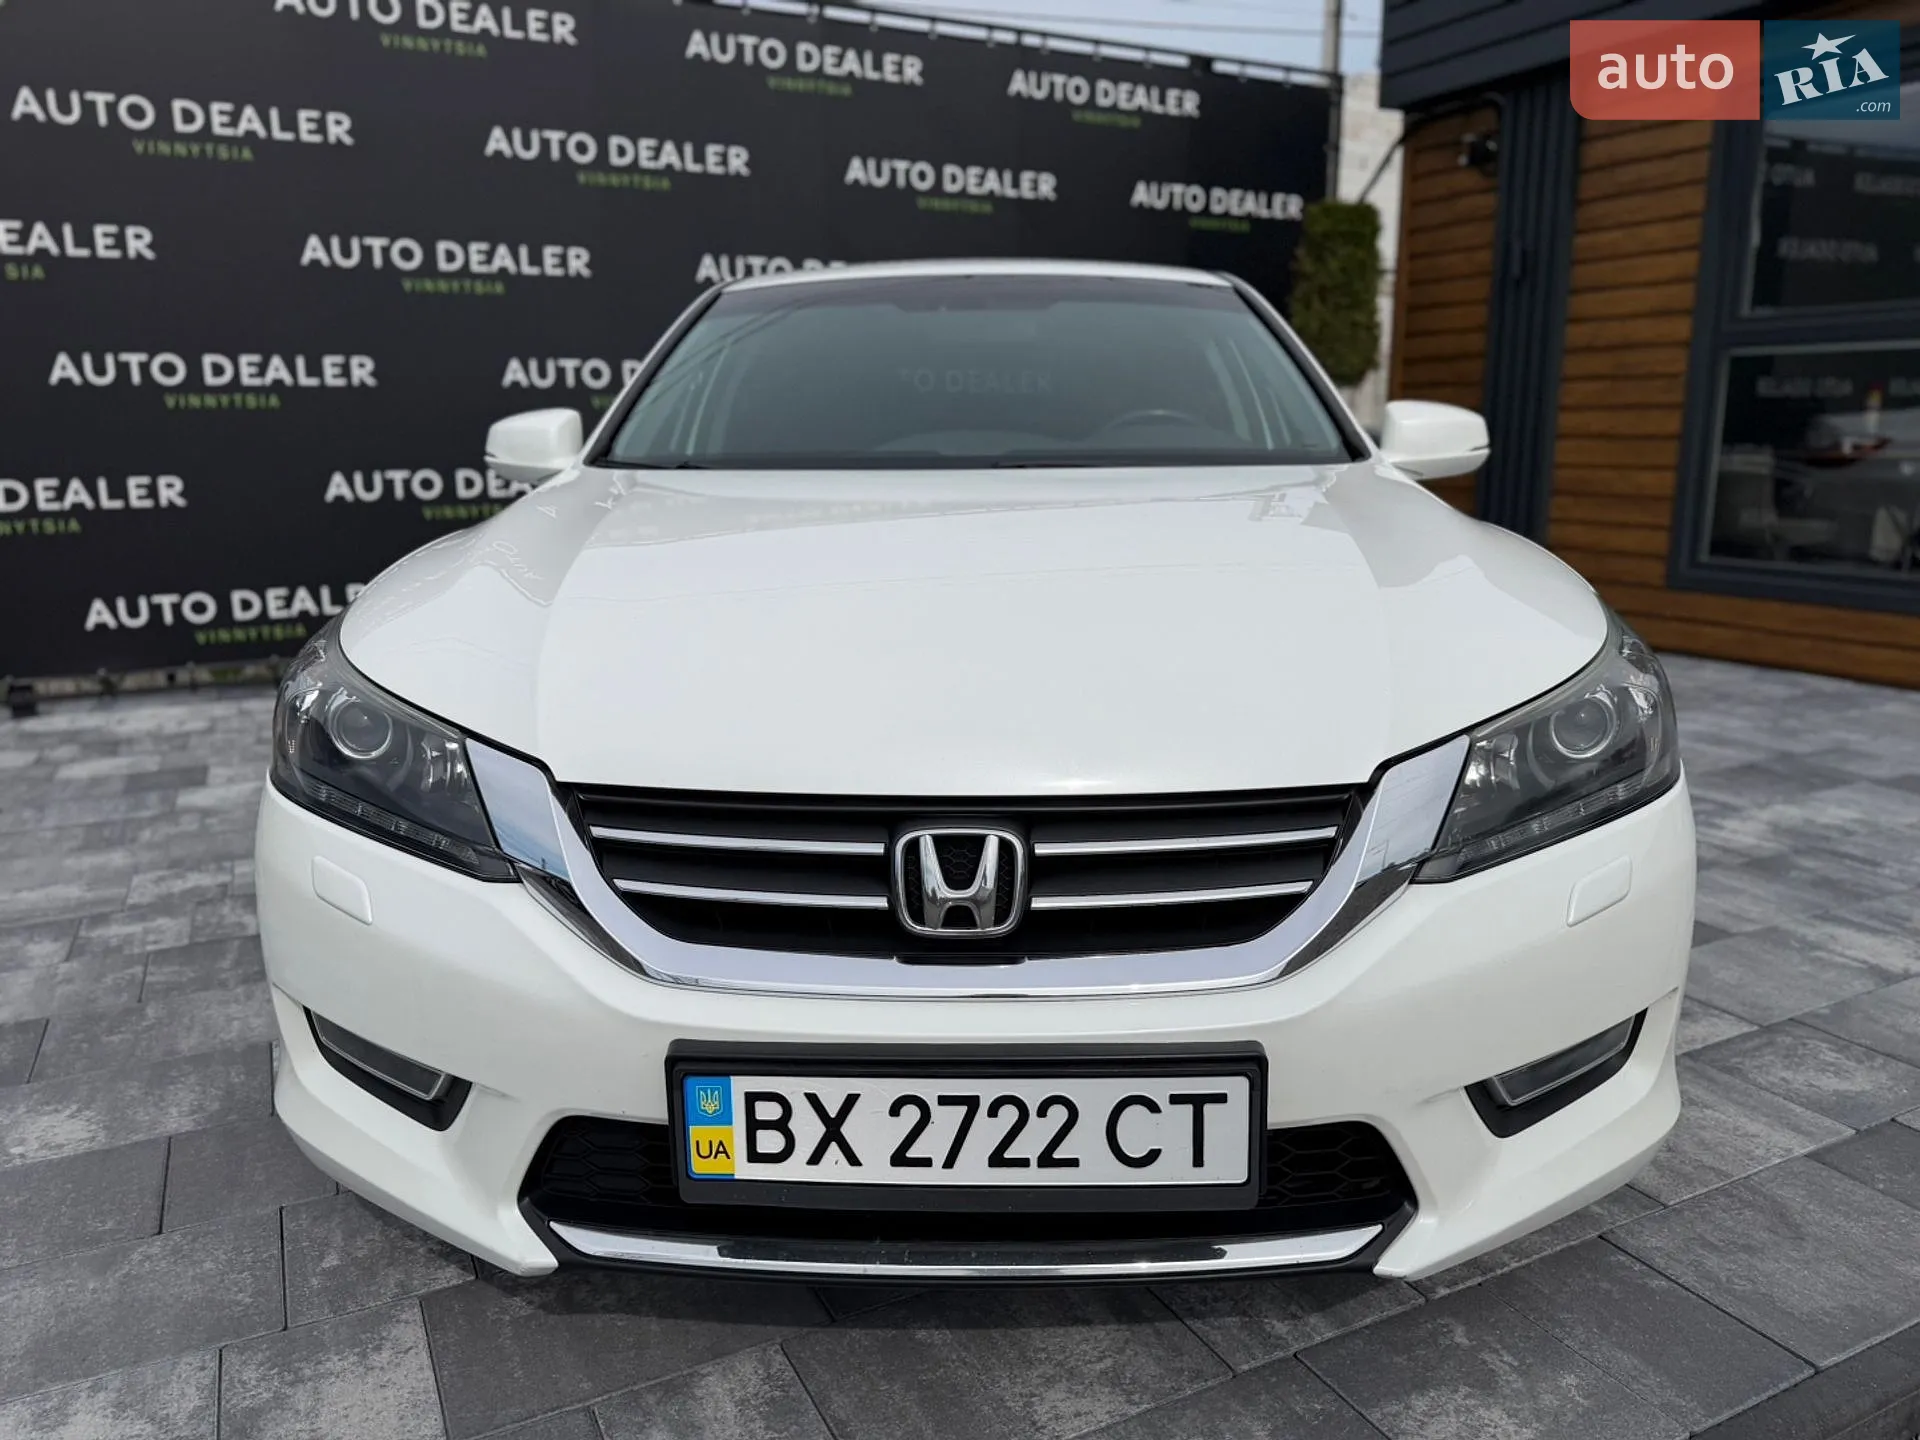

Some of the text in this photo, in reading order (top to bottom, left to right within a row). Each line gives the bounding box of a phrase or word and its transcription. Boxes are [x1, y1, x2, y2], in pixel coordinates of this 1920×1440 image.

[415, 0, 578, 46] DEALER
[684, 28, 925, 86] AUTO DEALER
[1006, 68, 1201, 117] AUTO DEALER
[11, 85, 355, 146] AUTO DEALER
[132, 139, 254, 162] VINNYTSIA
[484, 125, 750, 177] AUTO DEALER
[844, 156, 1058, 201] AUTO DEALER
[1130, 179, 1305, 220] AUTO DEALER
[300, 233, 592, 278] AUTO DEALER
[48, 351, 378, 387] AUTO DEALER
[501, 356, 613, 390] AUTO
[0, 474, 188, 513] DEALER
[324, 468, 445, 503] AUTO
[84, 590, 218, 632] AUTO
[695, 1139, 731, 1161] UA
[744, 1091, 1229, 1170] BX 2722 CT
